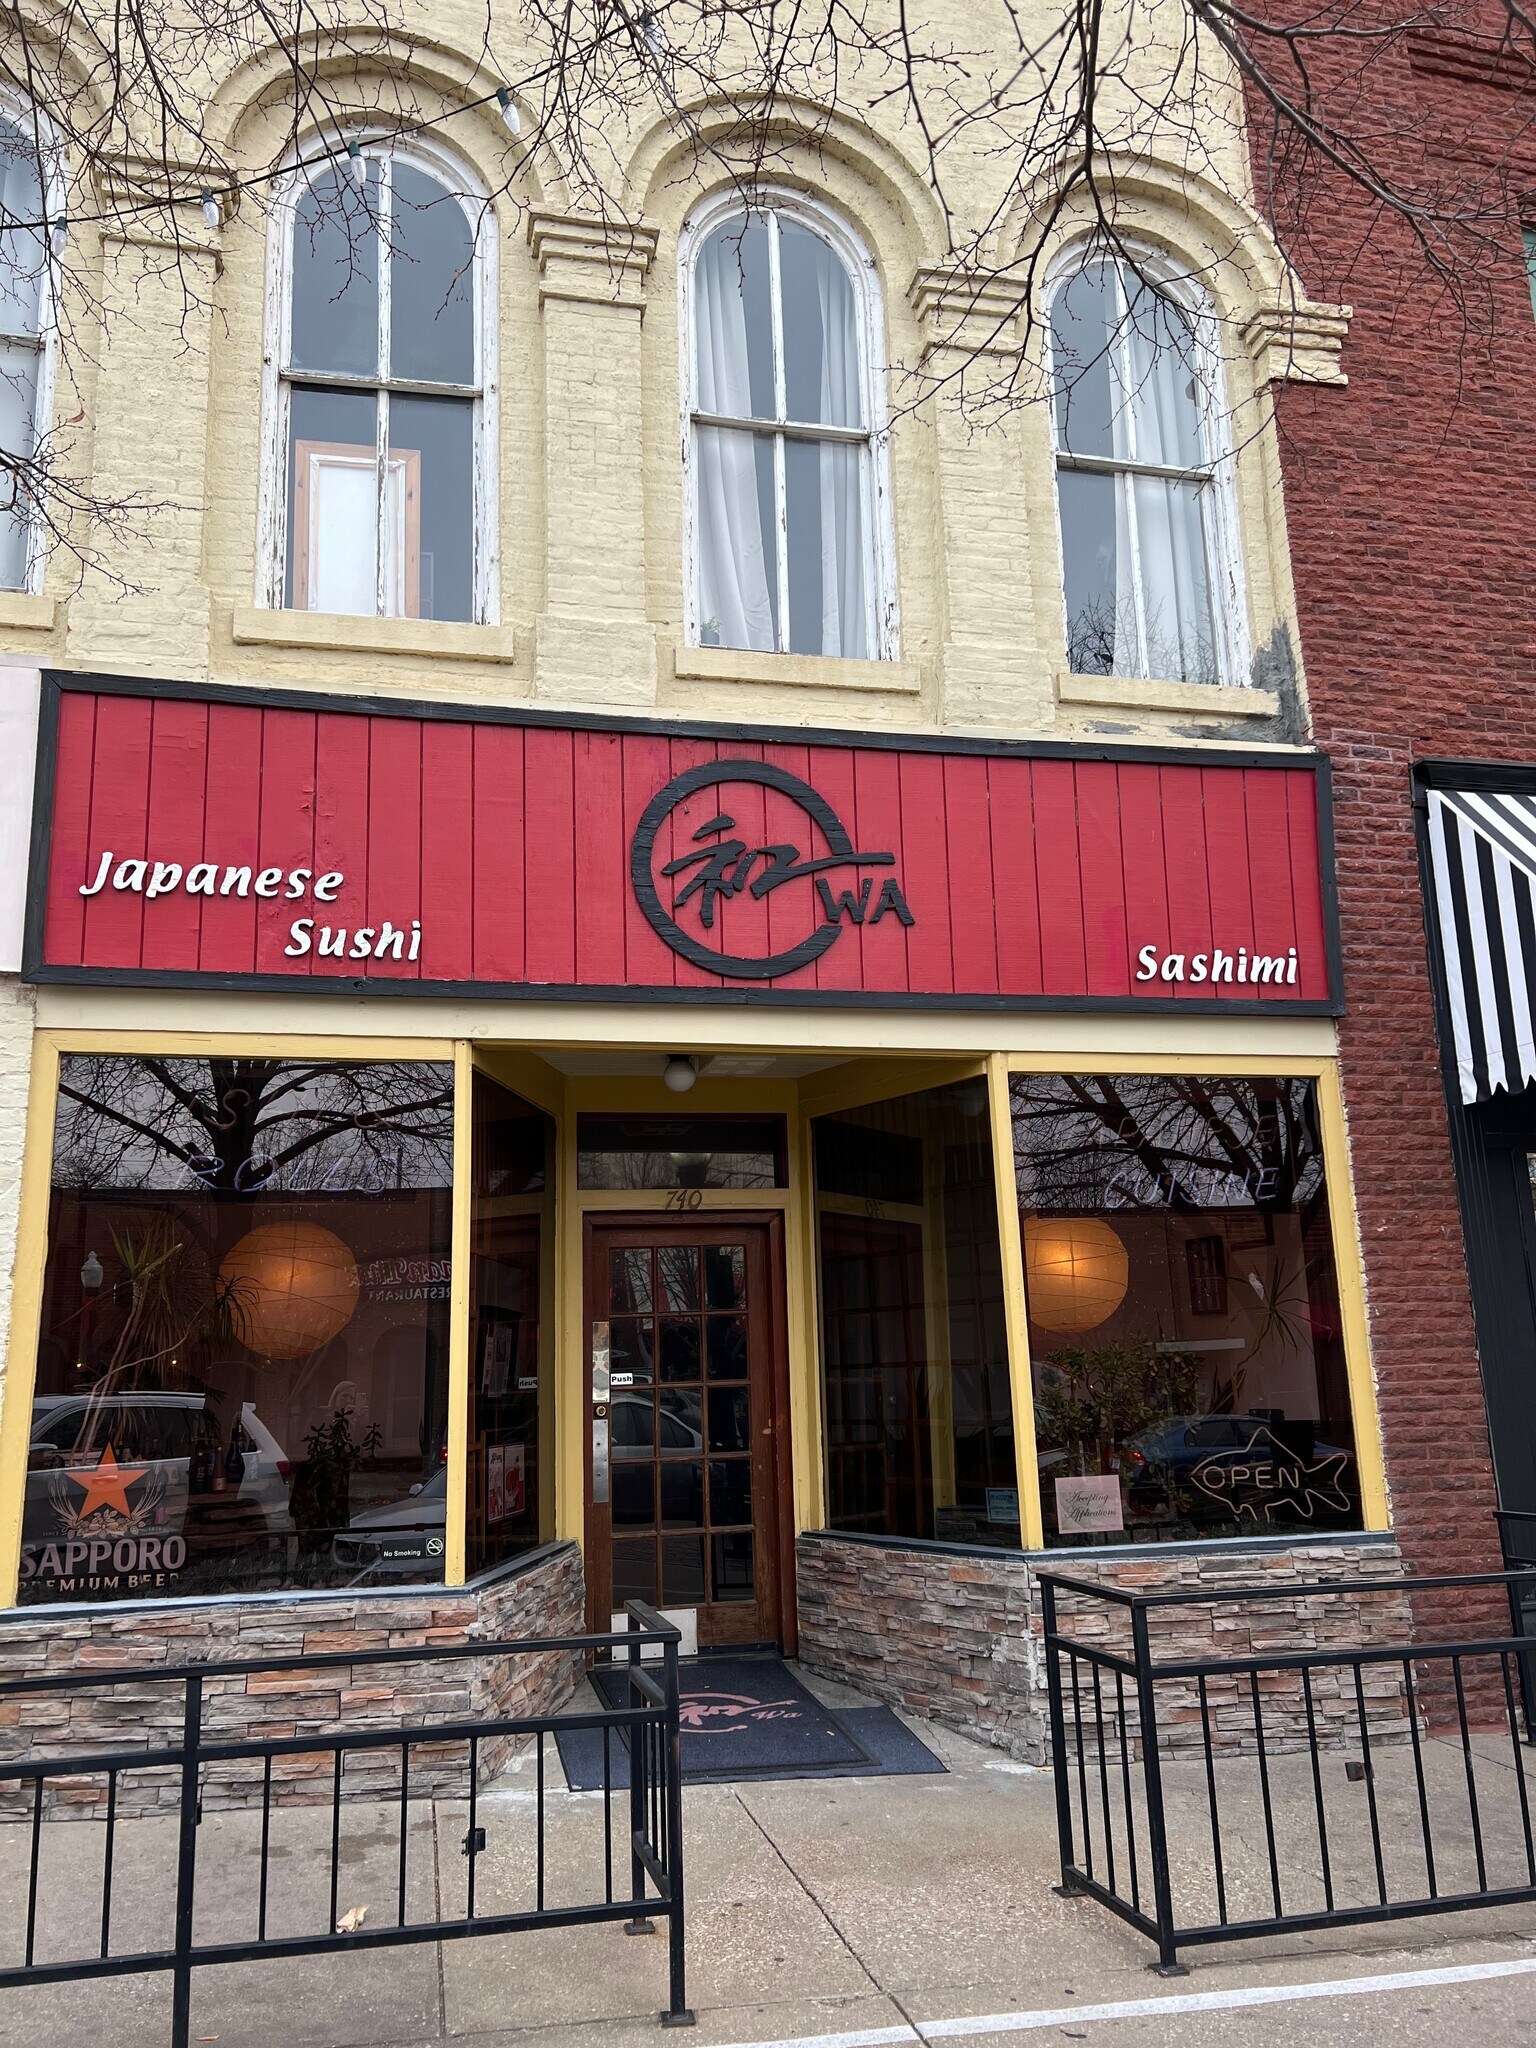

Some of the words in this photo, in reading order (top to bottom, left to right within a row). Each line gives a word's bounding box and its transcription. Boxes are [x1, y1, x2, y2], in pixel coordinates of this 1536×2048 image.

[79, 851, 344, 901] Japanese
[816, 878, 915, 925] WA
[284, 918, 421, 960] Sushi
[1136, 944, 1298, 984] Sashimi
[665, 1190, 703, 1210] 740
[1104, 1167, 1280, 1209] CUISINE
[611, 1375, 632, 1383] Push
[1202, 1465, 1299, 1489] OPEN
[1064, 1507, 1117, 1522] Applications
[1066, 1490, 1109, 1509] Accepting
[18, 1536, 187, 1579] SAPPORO
[751, 1710, 802, 1720] Wa
